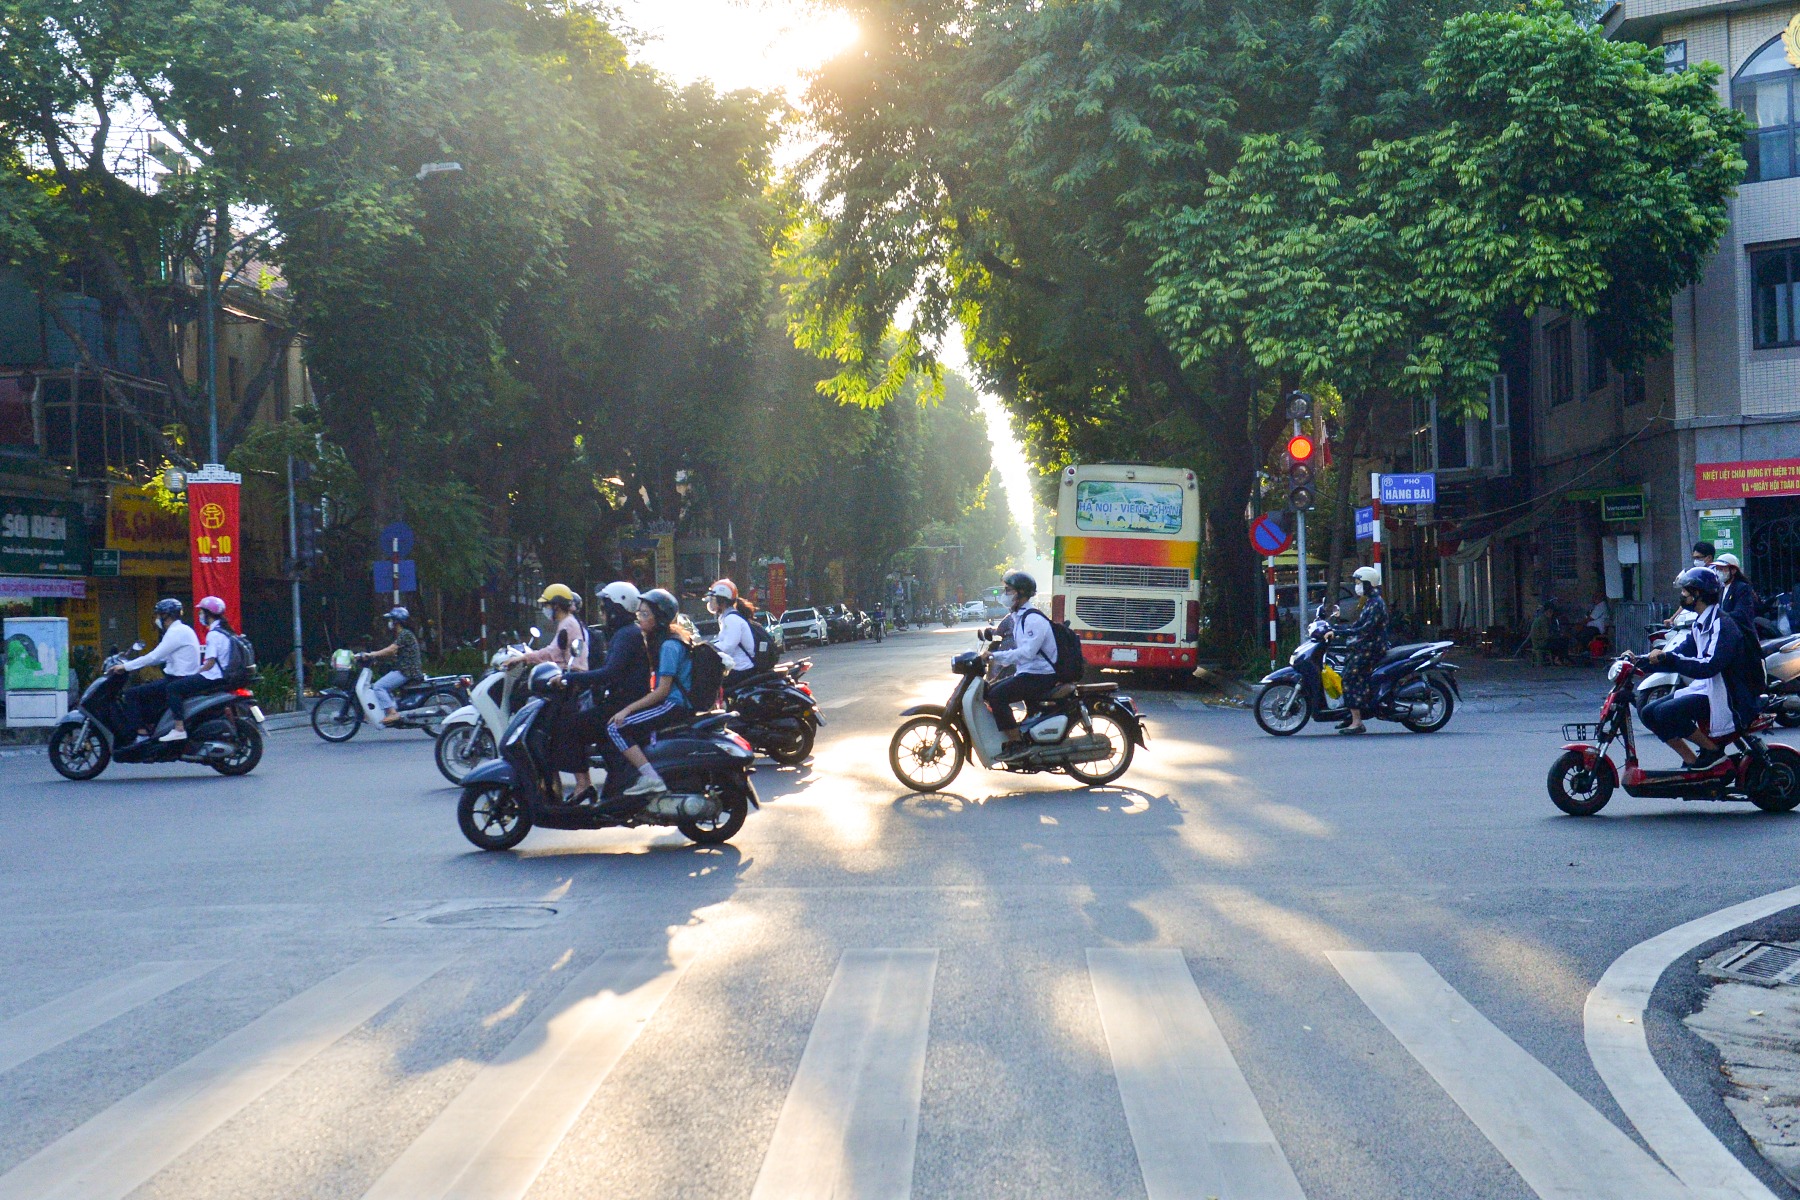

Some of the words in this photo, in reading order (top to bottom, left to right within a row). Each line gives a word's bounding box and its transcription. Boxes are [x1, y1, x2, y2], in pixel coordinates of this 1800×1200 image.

[1403, 476, 1420, 484] PHỐ
[1385, 487, 1411, 500] HÀNG
[1414, 486, 1430, 499] BÀI
